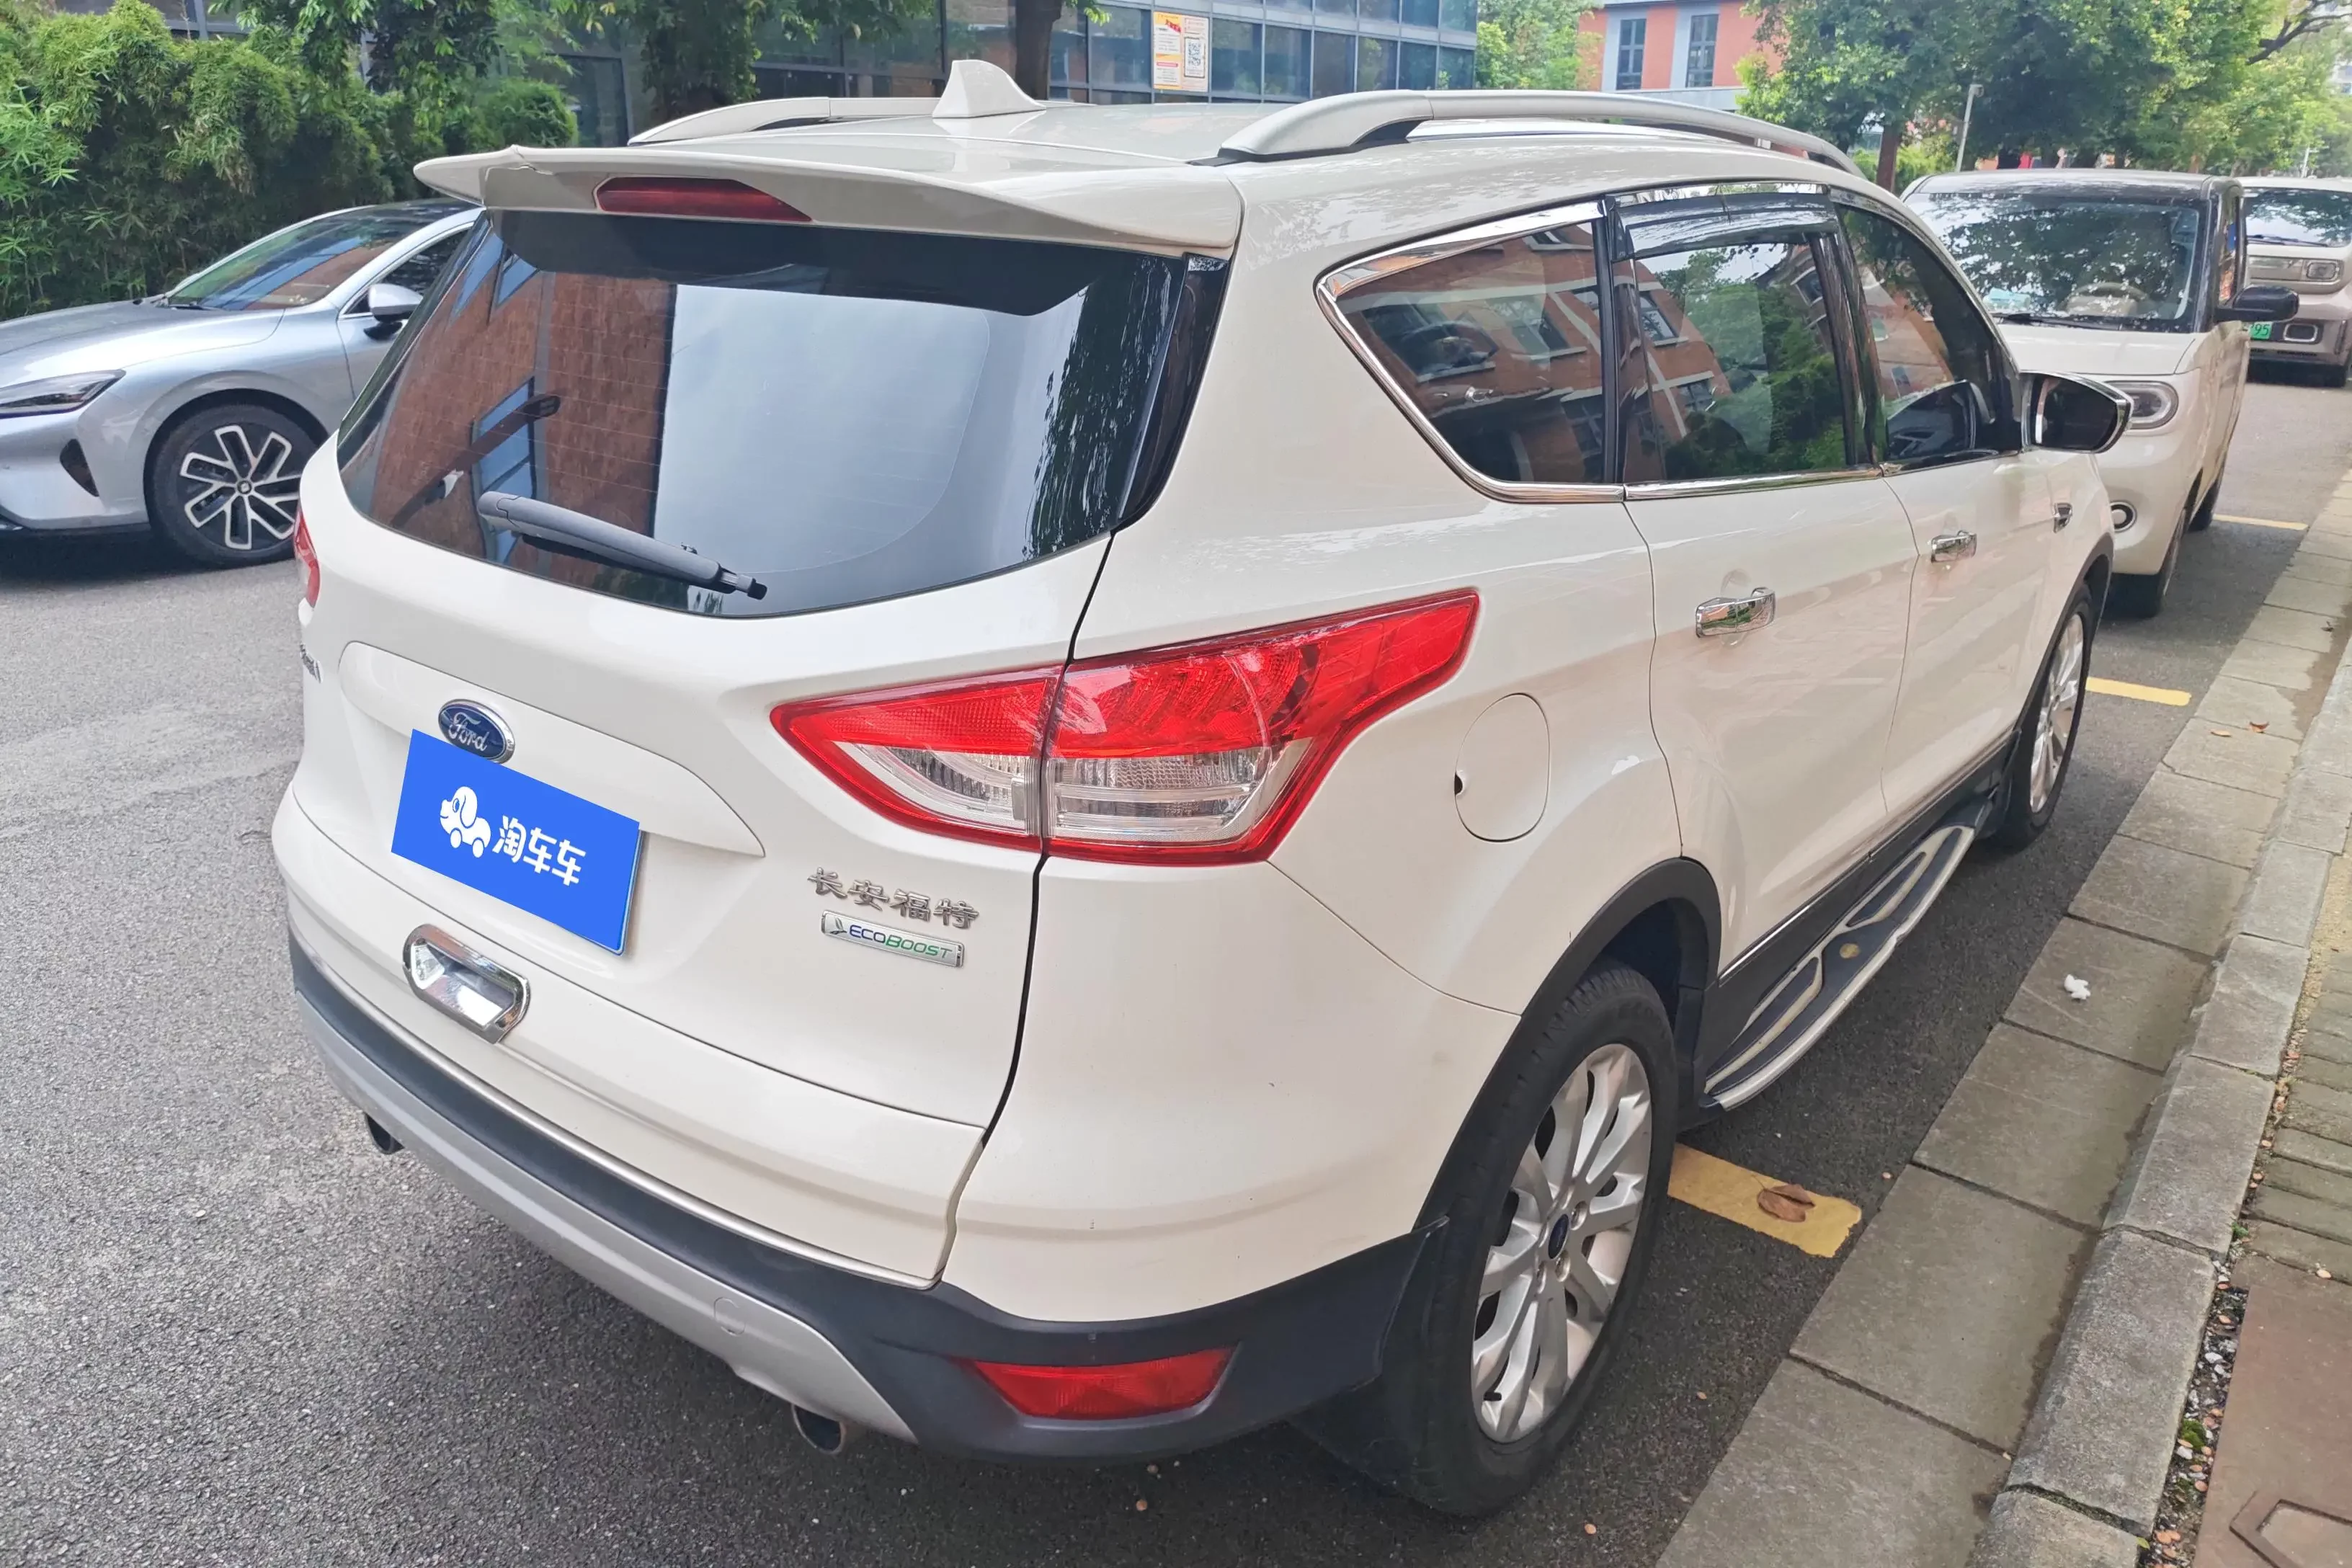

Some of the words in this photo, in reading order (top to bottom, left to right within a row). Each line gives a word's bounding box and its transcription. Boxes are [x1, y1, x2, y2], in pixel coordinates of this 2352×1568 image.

[448, 712, 489, 752] Ford
[807, 867, 979, 930] 长安福特
[849, 925, 953, 959] ECOBOOST
